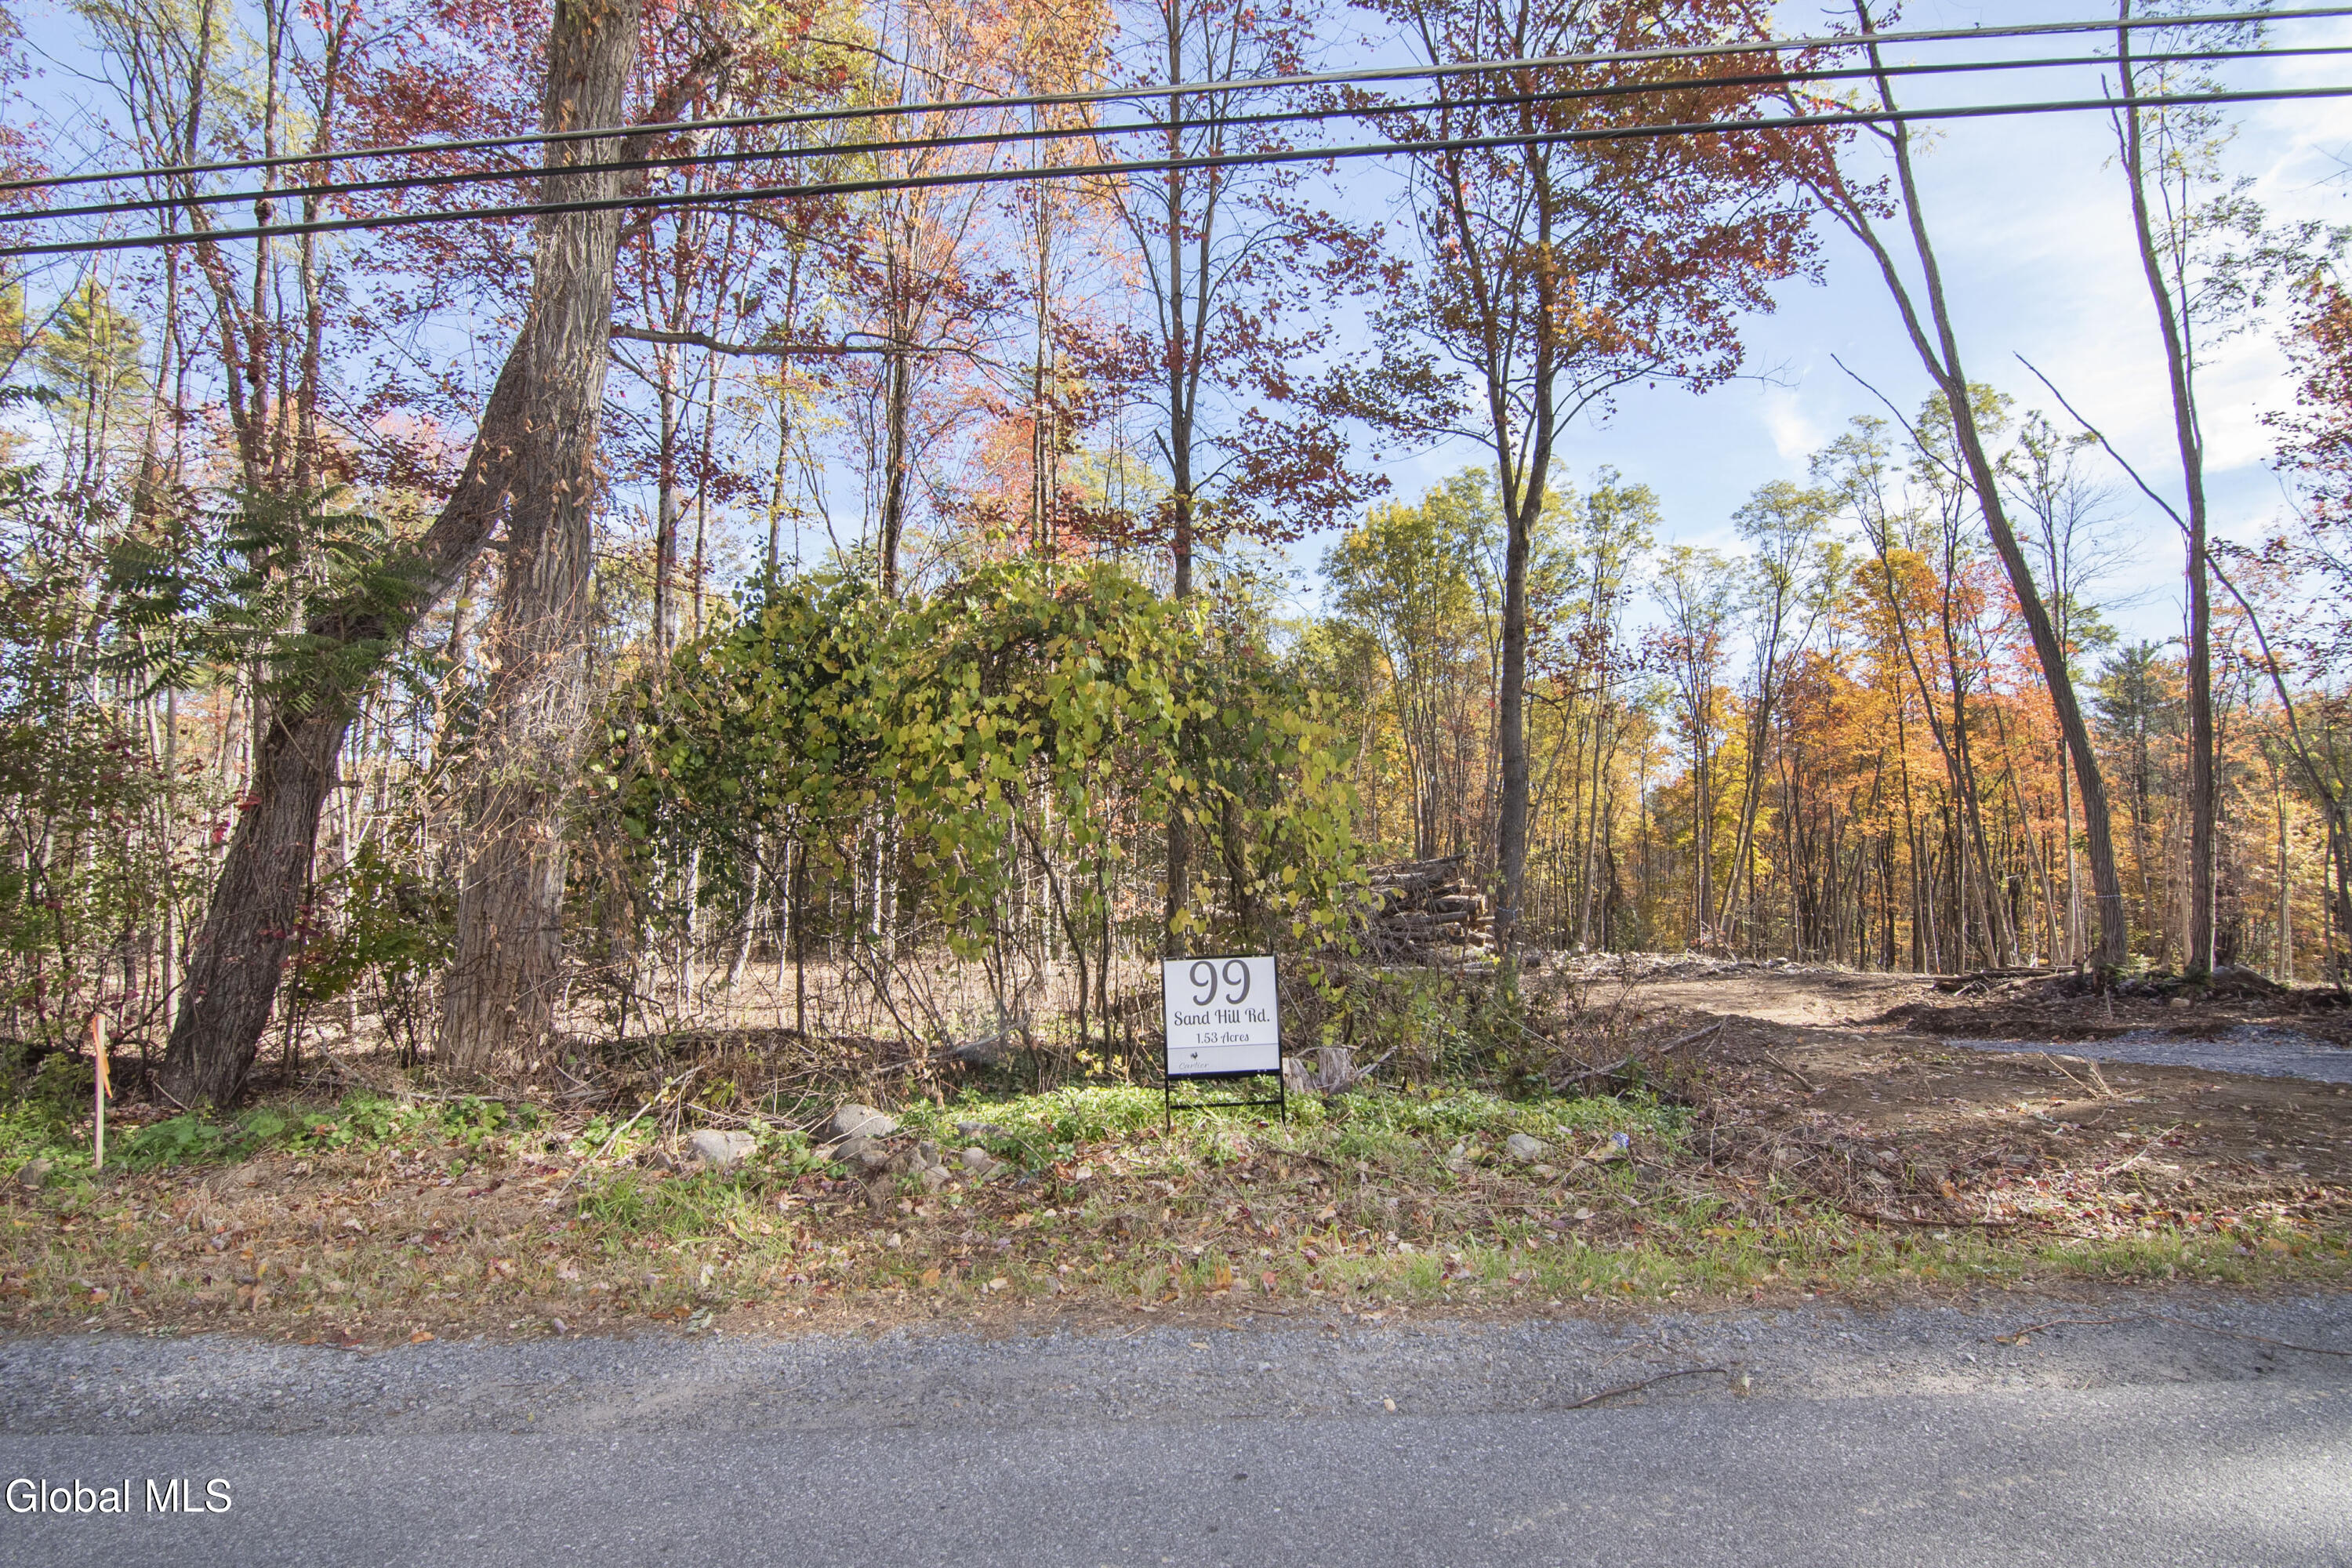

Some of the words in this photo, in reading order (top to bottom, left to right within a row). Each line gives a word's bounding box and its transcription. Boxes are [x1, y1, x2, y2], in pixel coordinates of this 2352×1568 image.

[1189, 959, 1250, 1006] 99
[1174, 1011, 1210, 1025] Sand
[1214, 1009, 1241, 1024] Hill
[1245, 1007, 1270, 1022] Rd.
[1196, 1032, 1218, 1044] 1.53
[1221, 1031, 1250, 1044] Acres
